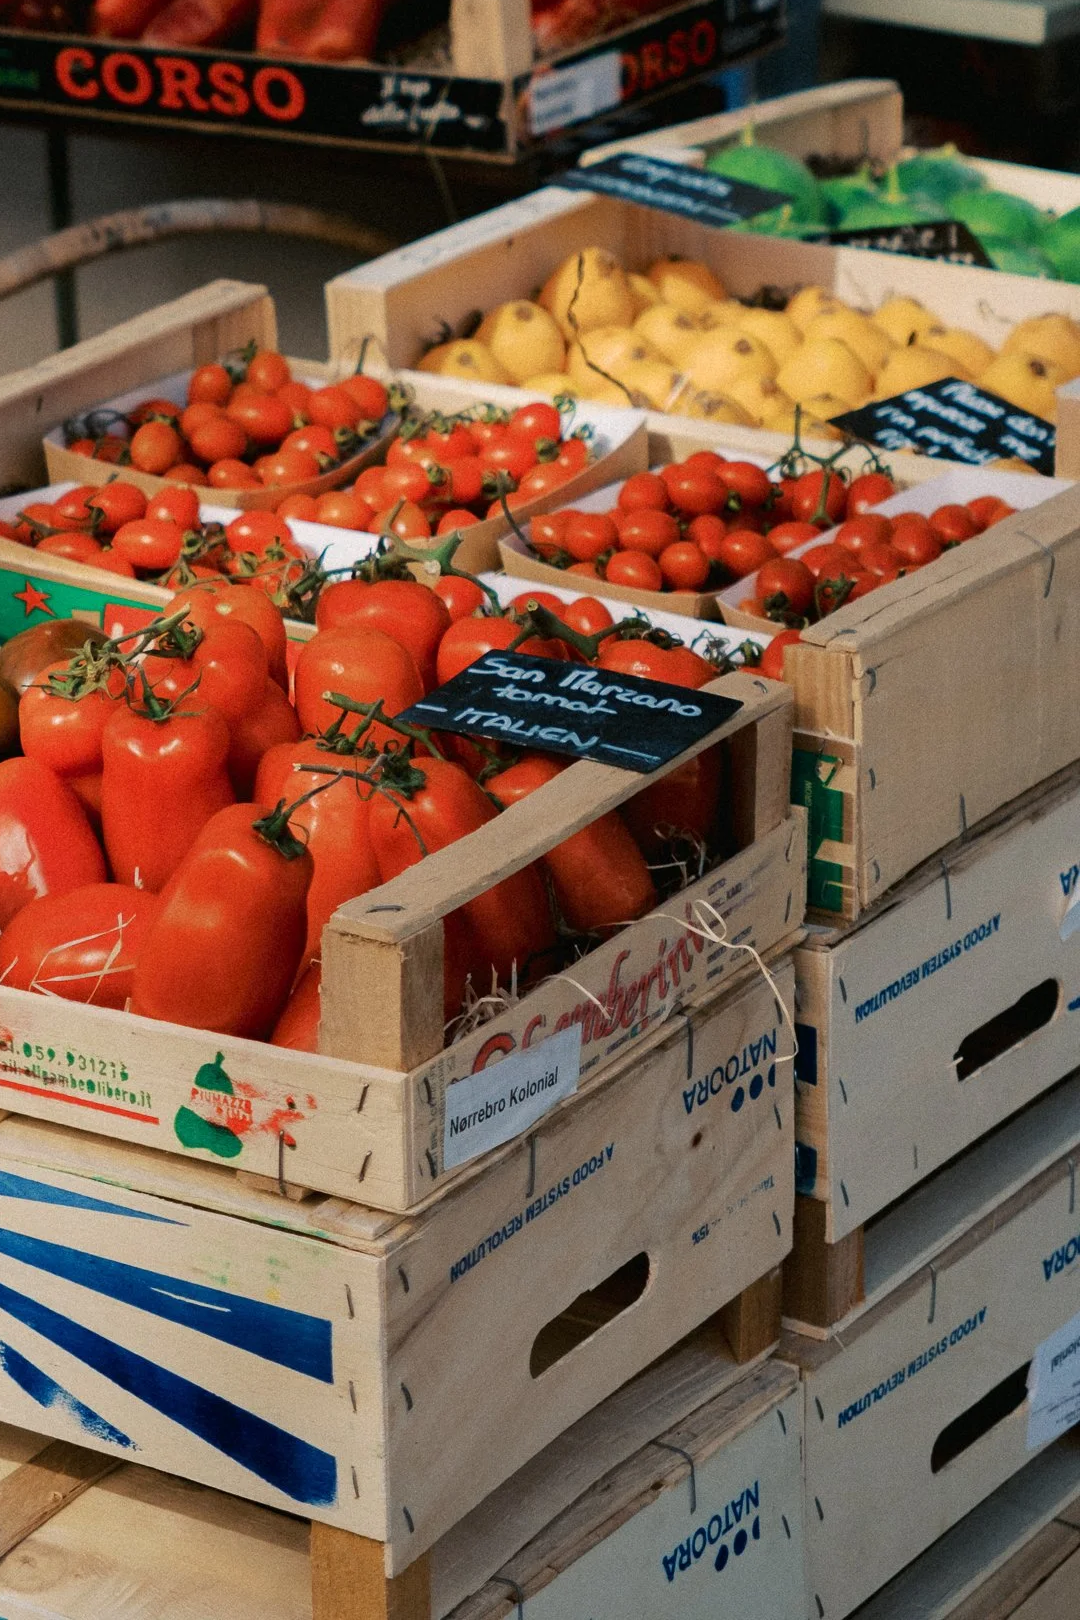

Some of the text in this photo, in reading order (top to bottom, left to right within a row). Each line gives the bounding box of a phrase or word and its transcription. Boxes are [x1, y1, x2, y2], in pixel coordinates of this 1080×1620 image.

[55, 47, 307, 121] CORSO
[622, 18, 717, 102] ORSO
[468, 657, 702, 717] San Marzano
[493, 683, 617, 715] tomat
[454, 706, 599, 749] ITALIEN
[920, 939, 964, 976] SYSTEM
[963, 921, 993, 952] FOOD
[855, 968, 920, 1024] REVOLUTION
[682, 1028, 777, 1114] NATOORA
[449, 1065, 559, 1138] Nørrebro Kolonial
[573, 1152, 605, 1187] FOOD
[525, 1176, 573, 1222] SYSTEM
[450, 1211, 523, 1283] REVOLUTION
[907, 1335, 951, 1373] SYSTEM
[950, 1315, 980, 1343] FOOD
[837, 1363, 908, 1428] REVOLUTION
[662, 1480, 760, 1582] NATOORA
